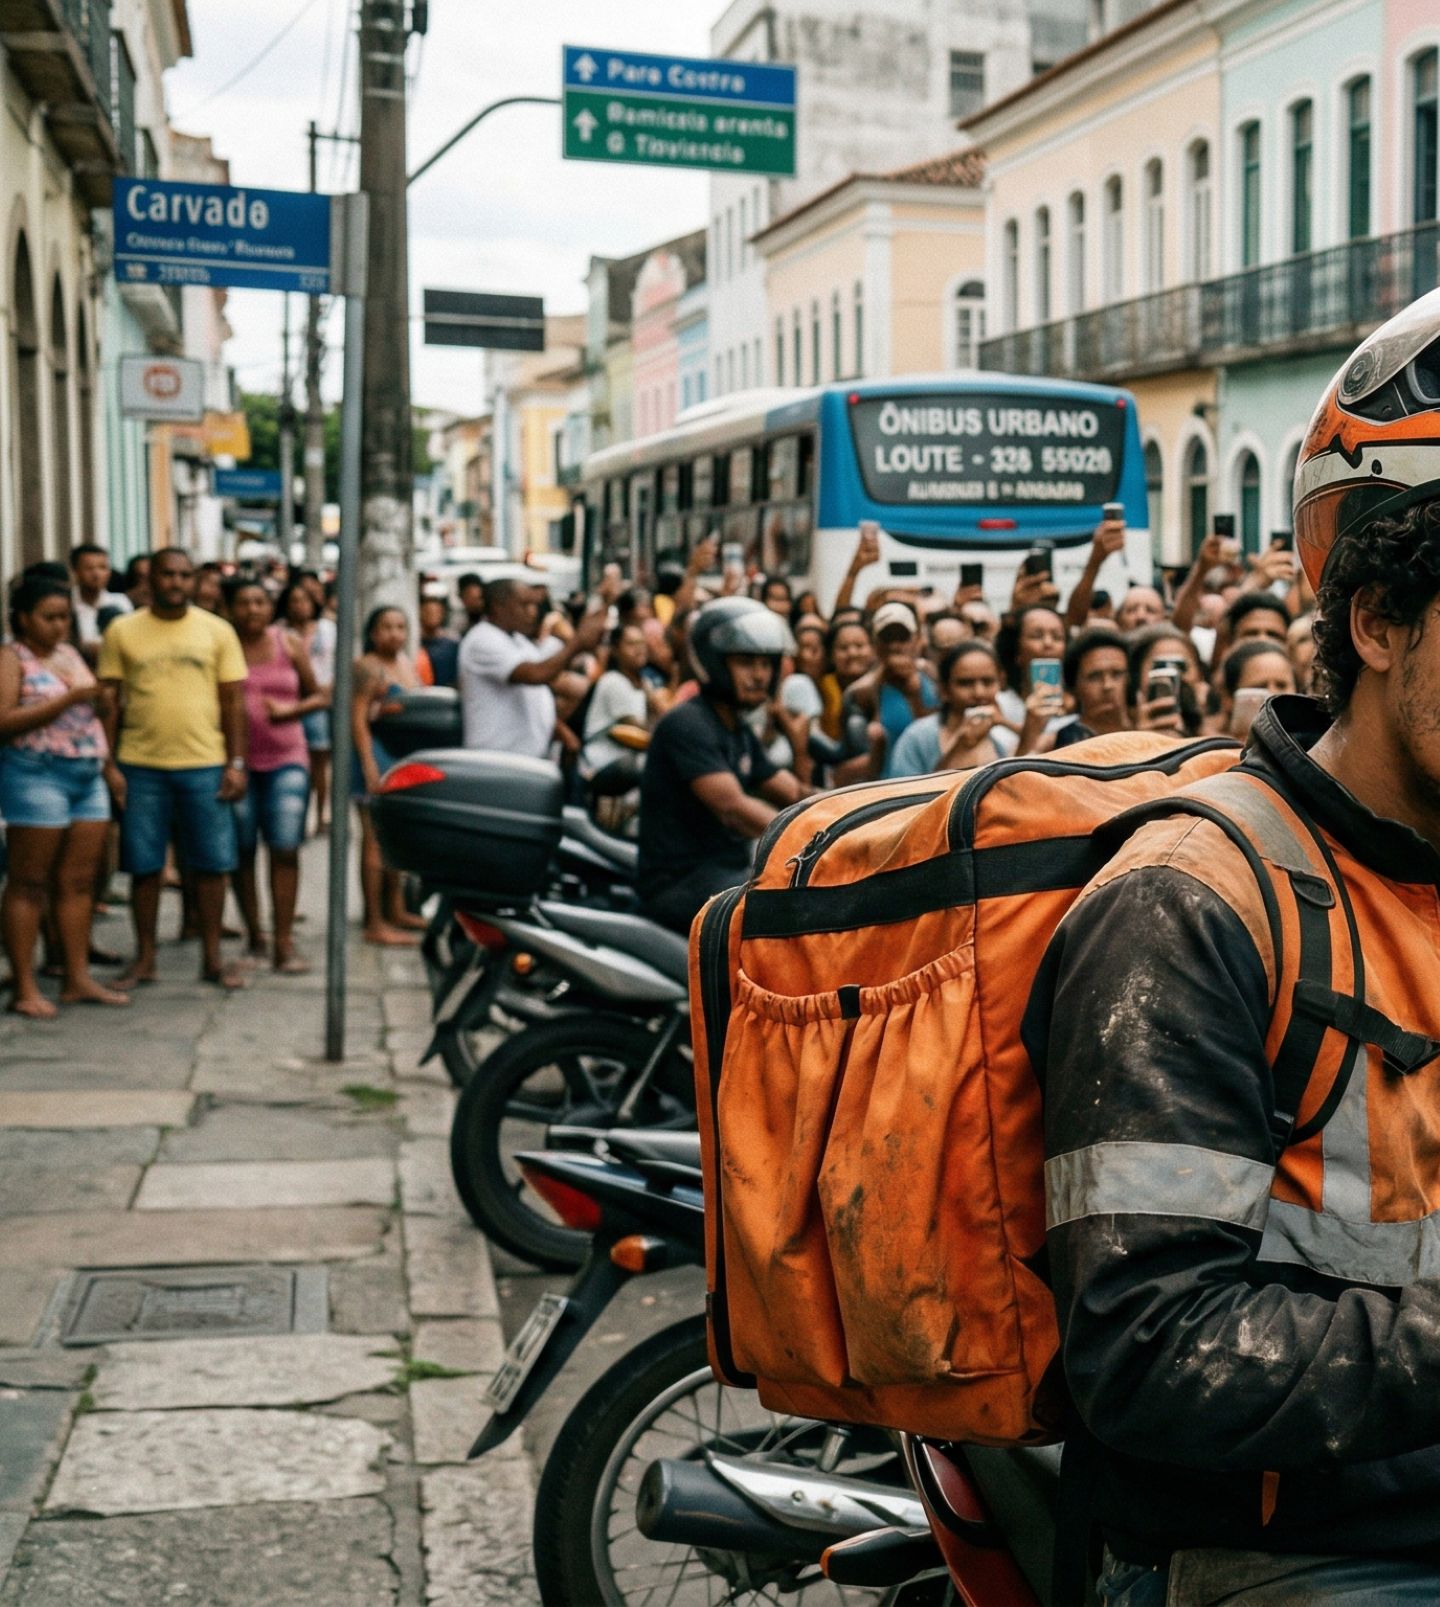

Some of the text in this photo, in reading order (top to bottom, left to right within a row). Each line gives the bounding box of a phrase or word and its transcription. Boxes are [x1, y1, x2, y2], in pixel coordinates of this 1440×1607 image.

[126, 184, 270, 230] Carvado
[879, 401, 1099, 438] ÔNIBUS URBANO
[875, 445, 963, 473] LOUTE
